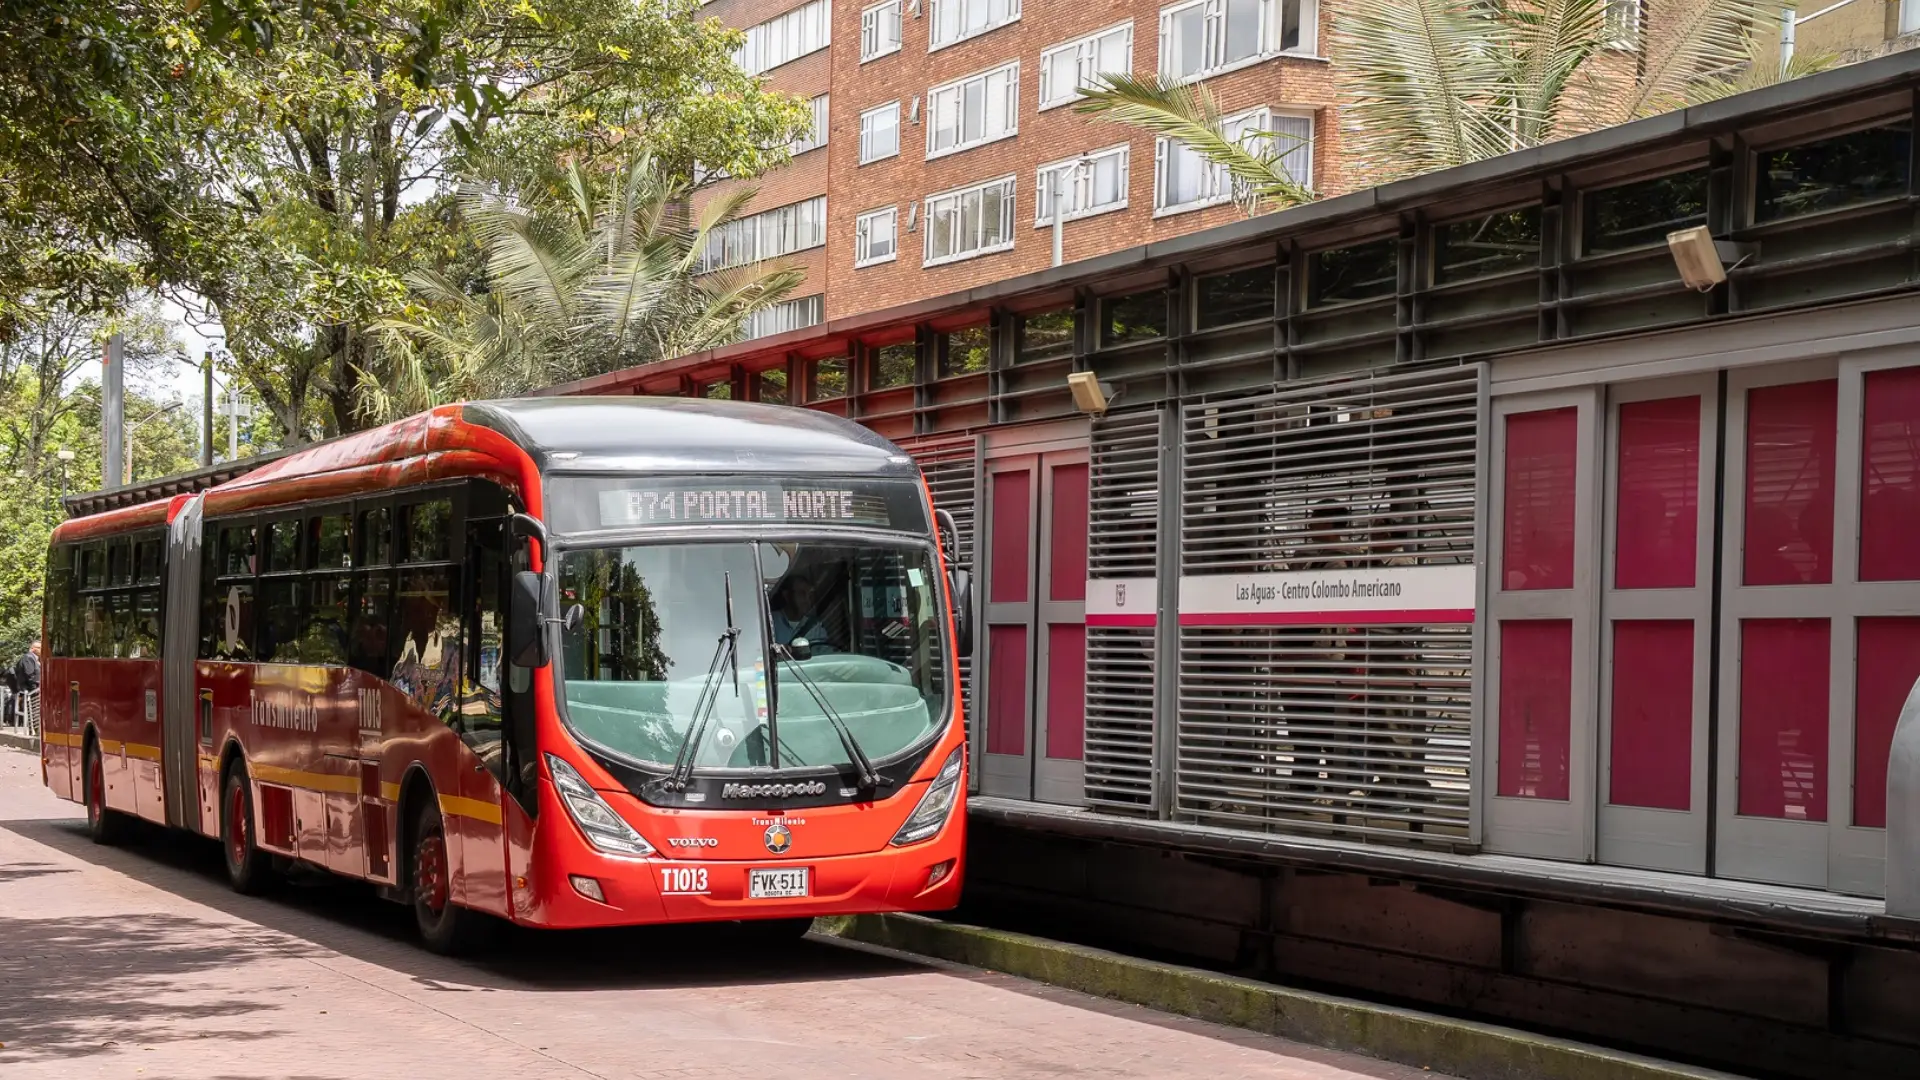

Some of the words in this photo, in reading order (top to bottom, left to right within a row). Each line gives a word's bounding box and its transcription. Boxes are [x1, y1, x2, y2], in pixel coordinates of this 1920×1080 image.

[683, 491, 776, 519] PORTAL
[783, 490, 854, 518] NORTE
[1236, 583, 1249, 600] Las
[1251, 583, 1275, 604] Aguas
[1282, 582, 1310, 599] Centro
[1311, 581, 1350, 598] Colombo
[1352, 578, 1401, 597] Americano
[250, 689, 318, 733] TransMilenio
[358, 687, 382, 729] T1013
[722, 780, 826, 799] Marcopolo
[667, 838, 719, 848] VOLVO
[661, 867, 709, 892] T1013
